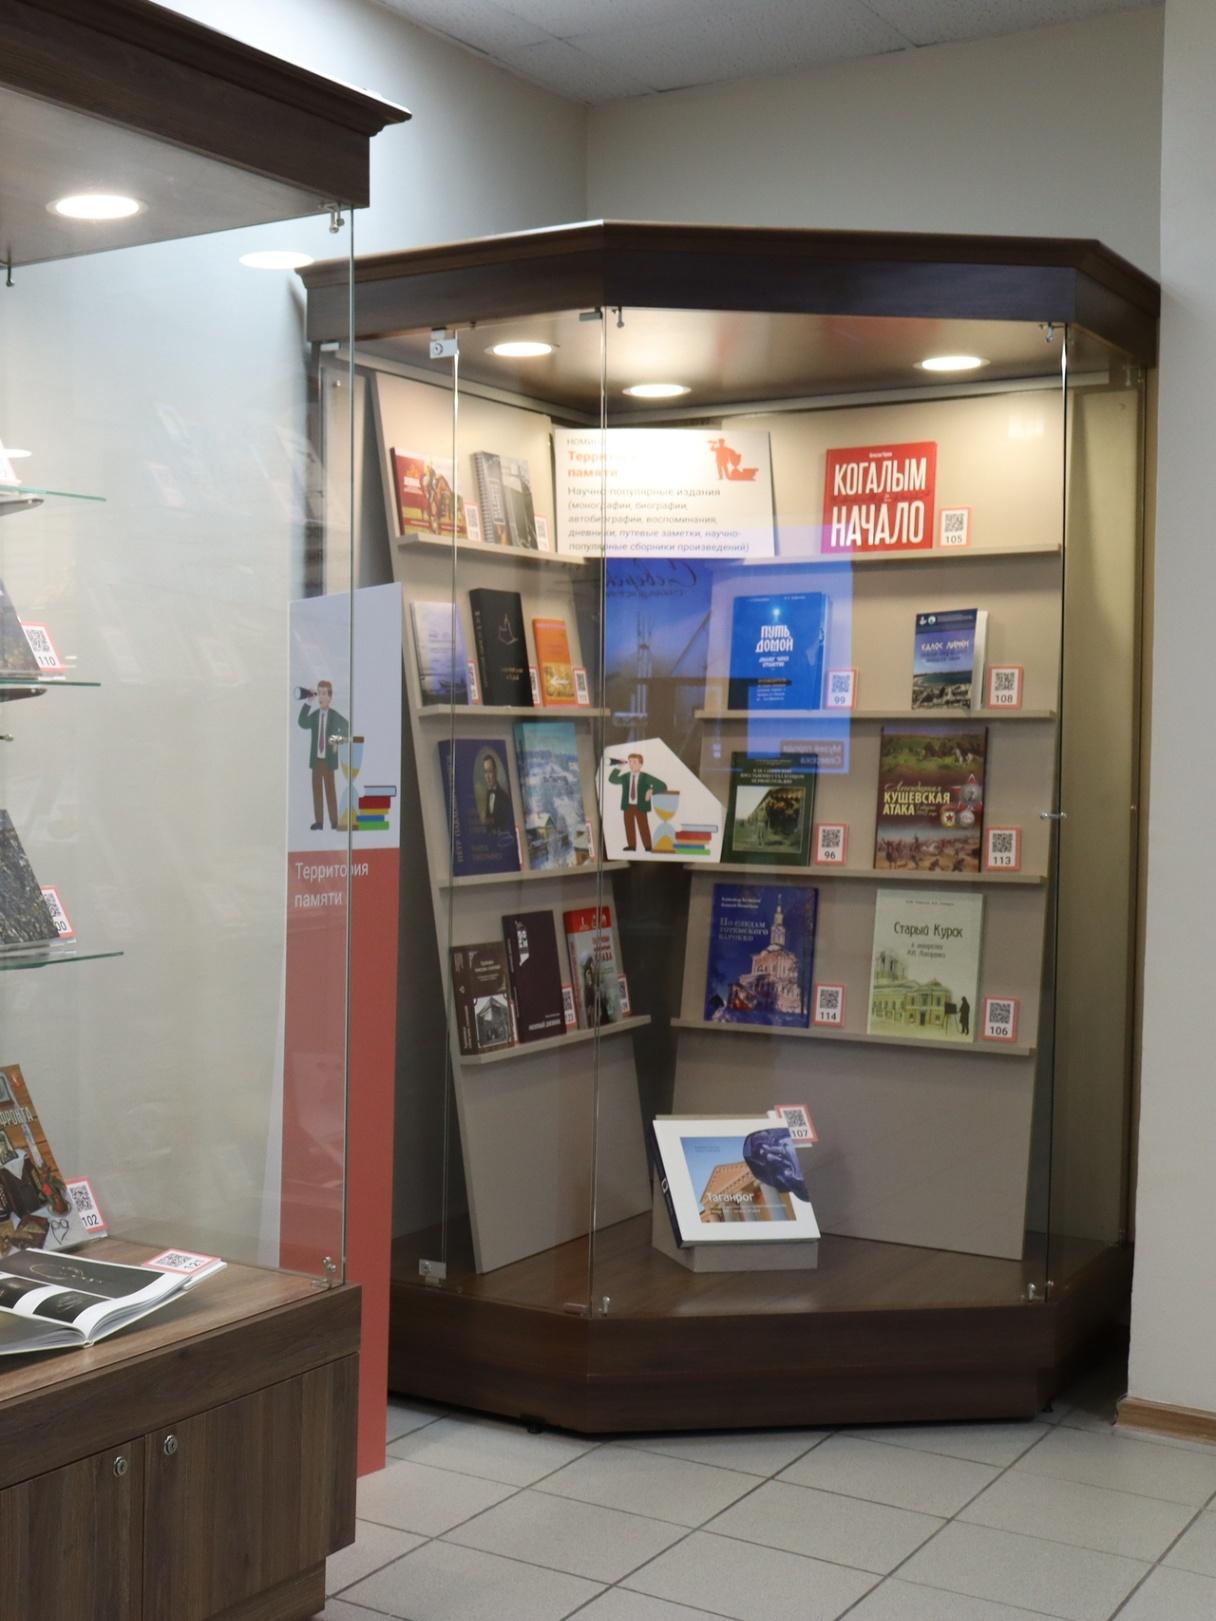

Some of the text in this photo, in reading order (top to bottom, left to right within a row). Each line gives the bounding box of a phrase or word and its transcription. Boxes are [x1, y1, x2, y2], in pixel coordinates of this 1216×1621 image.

[833, 457, 927, 496] КОГАЛЫМ
[677, 488, 721, 498] издания
[830, 500, 925, 548] НАЧАЛО
[945, 535, 963, 544] 105
[630, 542, 675, 551] сборники
[760, 625, 791, 638] ПУТЬ
[38, 656, 56, 667] 110
[882, 804, 915, 815] АТАКА
[824, 850, 836, 860] 96
[993, 856, 1012, 865] 113
[294, 892, 343, 908] памяти
[894, 921, 929, 938] Старый
[820, 1011, 837, 1021] 114
[990, 1026, 1008, 1037] 106
[791, 1130, 809, 1138] 107
[706, 1192, 754, 1204] Таганрог
[83, 1213, 99, 1227] 102
